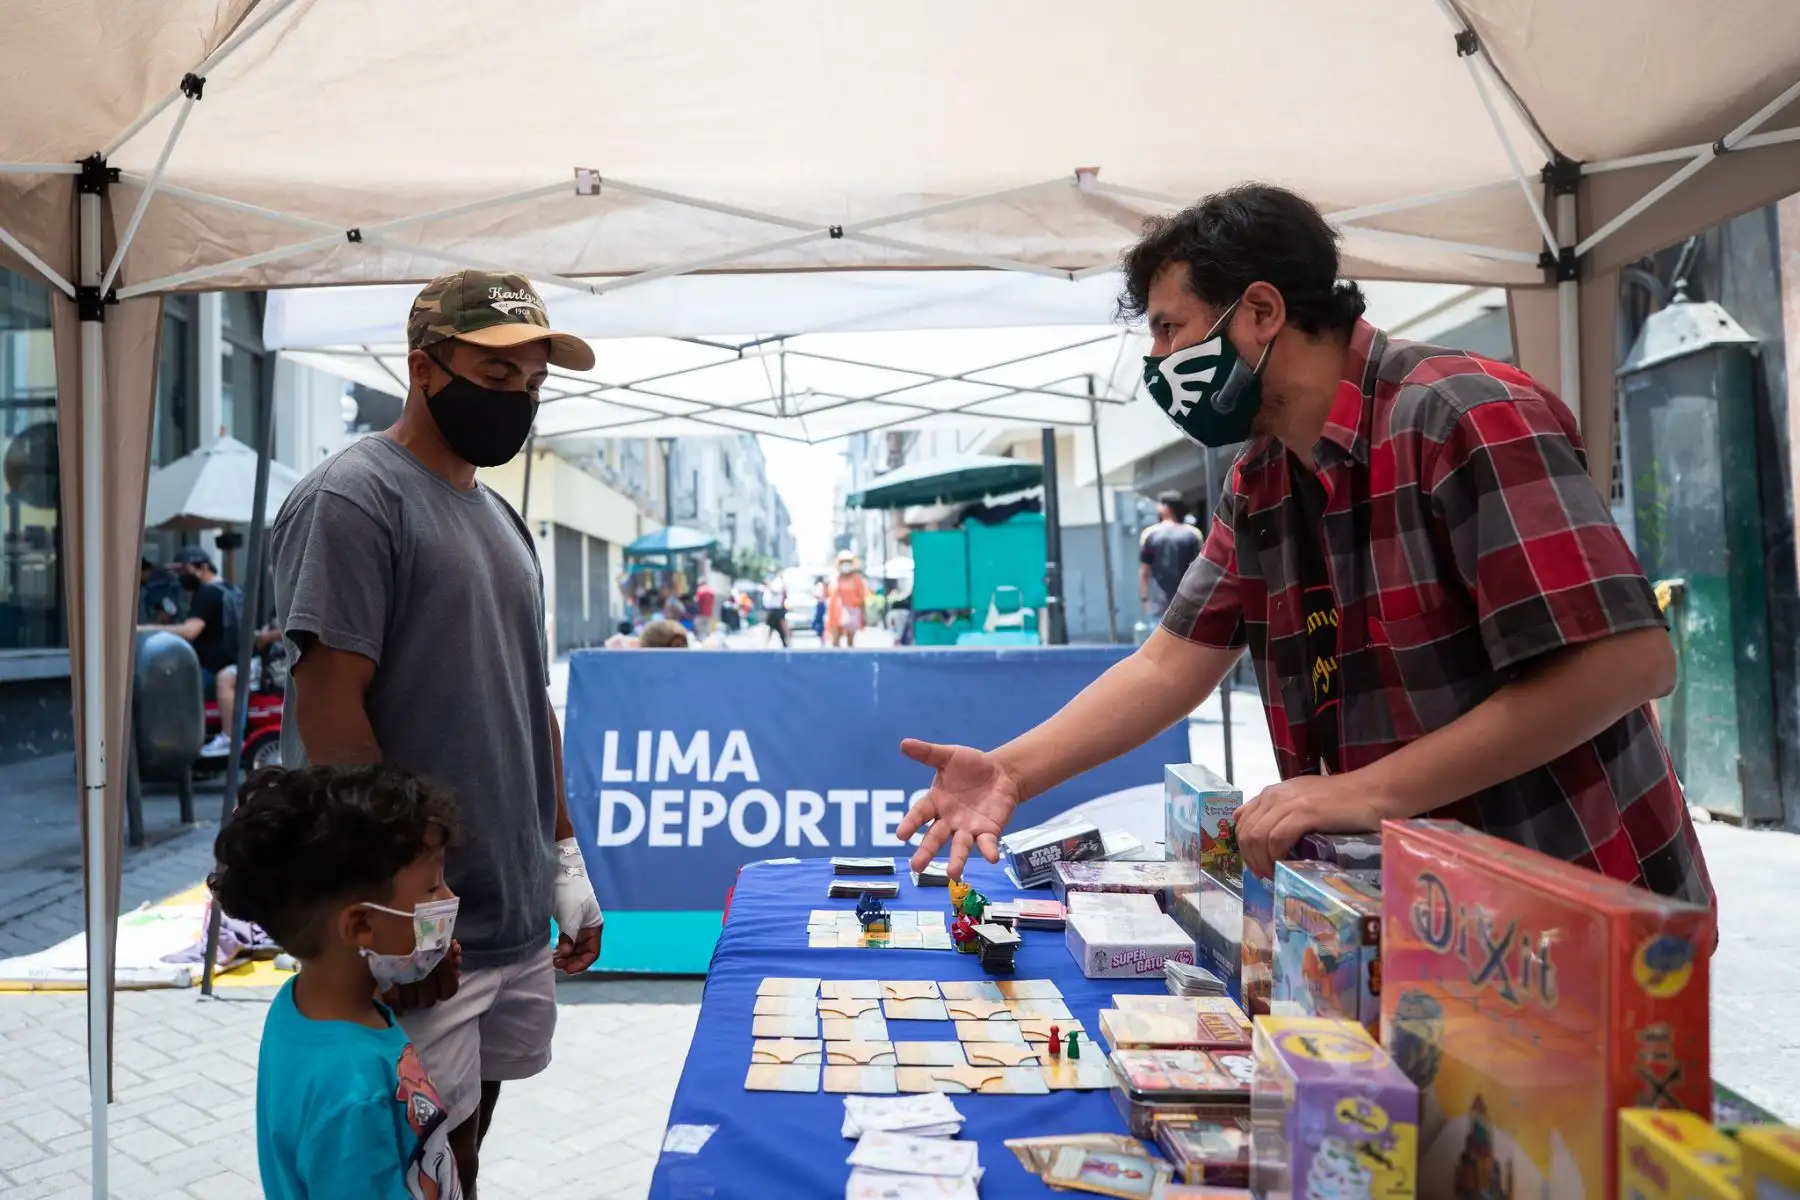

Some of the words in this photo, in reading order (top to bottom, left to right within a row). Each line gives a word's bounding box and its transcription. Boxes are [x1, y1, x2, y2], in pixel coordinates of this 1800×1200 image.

[602, 730, 760, 782] LIMA
[1027, 848, 1062, 868] WARS
[1031, 844, 1058, 861] STAR
